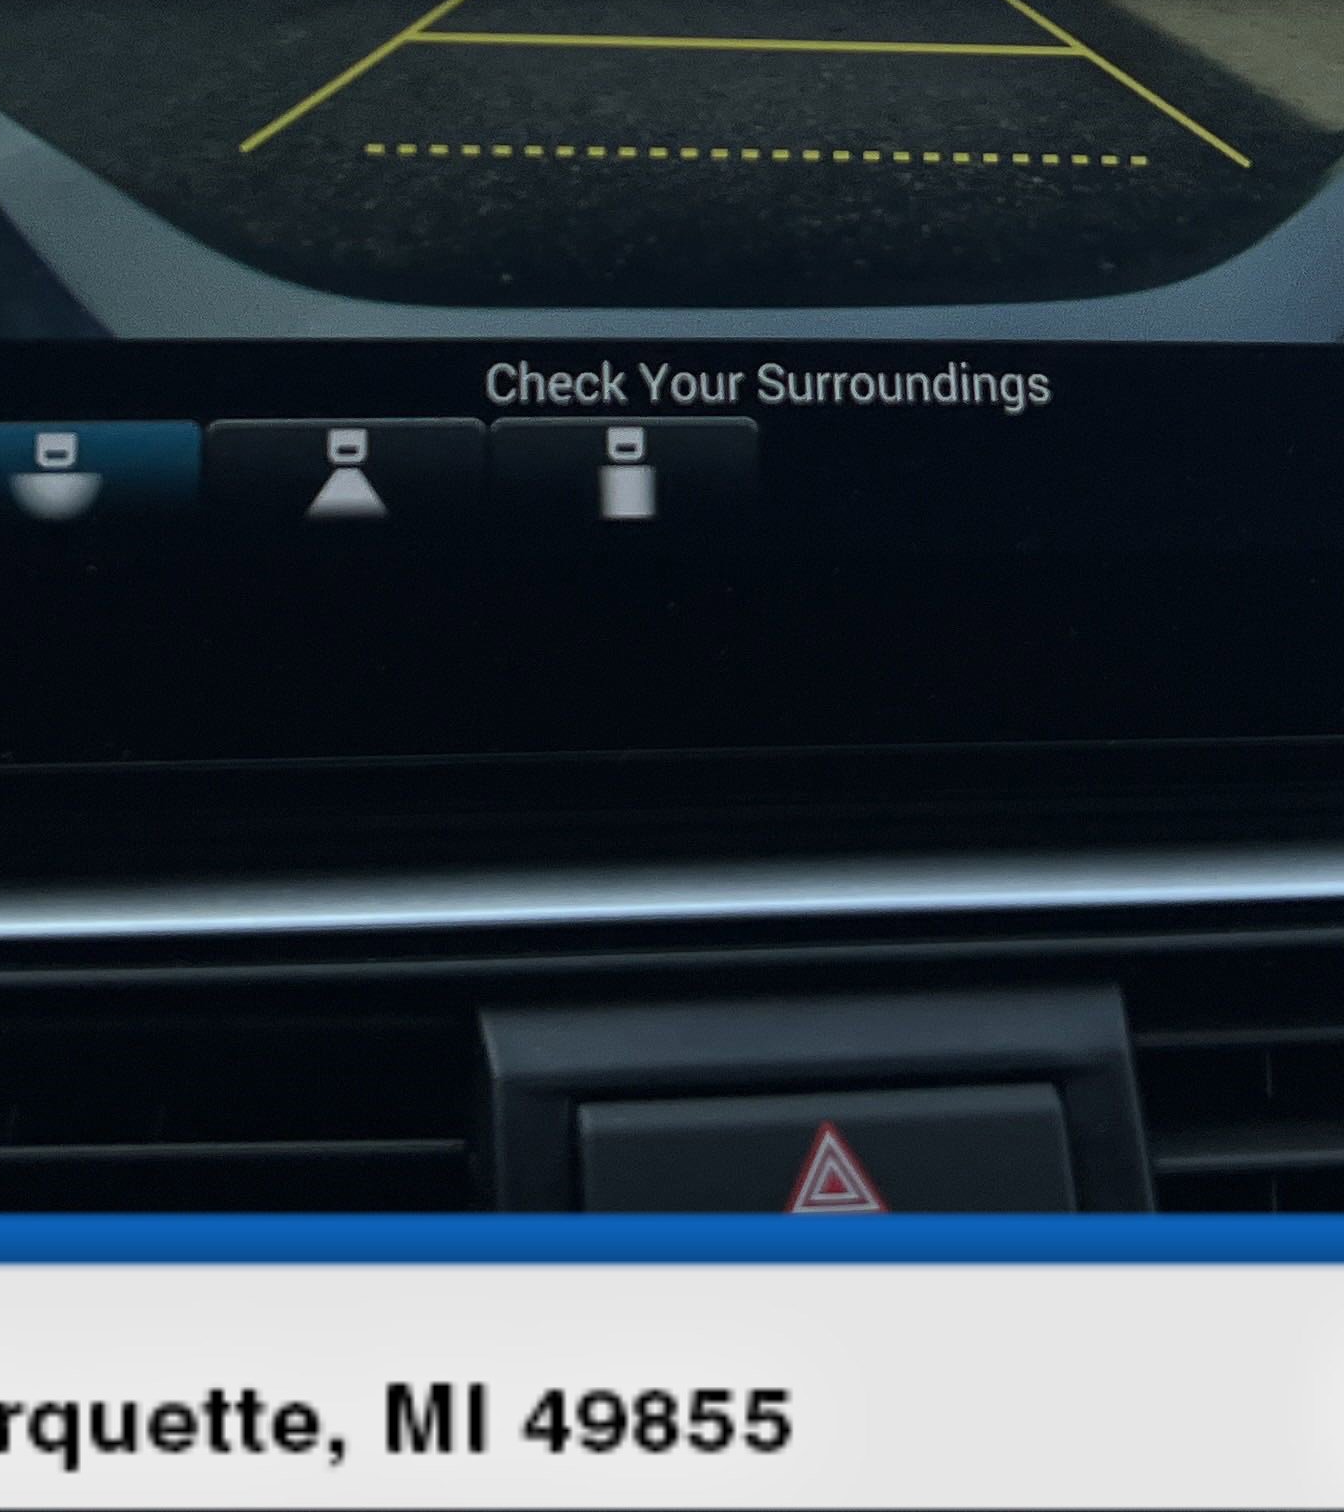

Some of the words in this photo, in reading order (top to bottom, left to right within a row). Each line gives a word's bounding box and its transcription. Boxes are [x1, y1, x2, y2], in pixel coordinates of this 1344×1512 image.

[485, 361, 628, 405] Check
[640, 363, 745, 405] Your
[757, 361, 1053, 416] Surroundings
